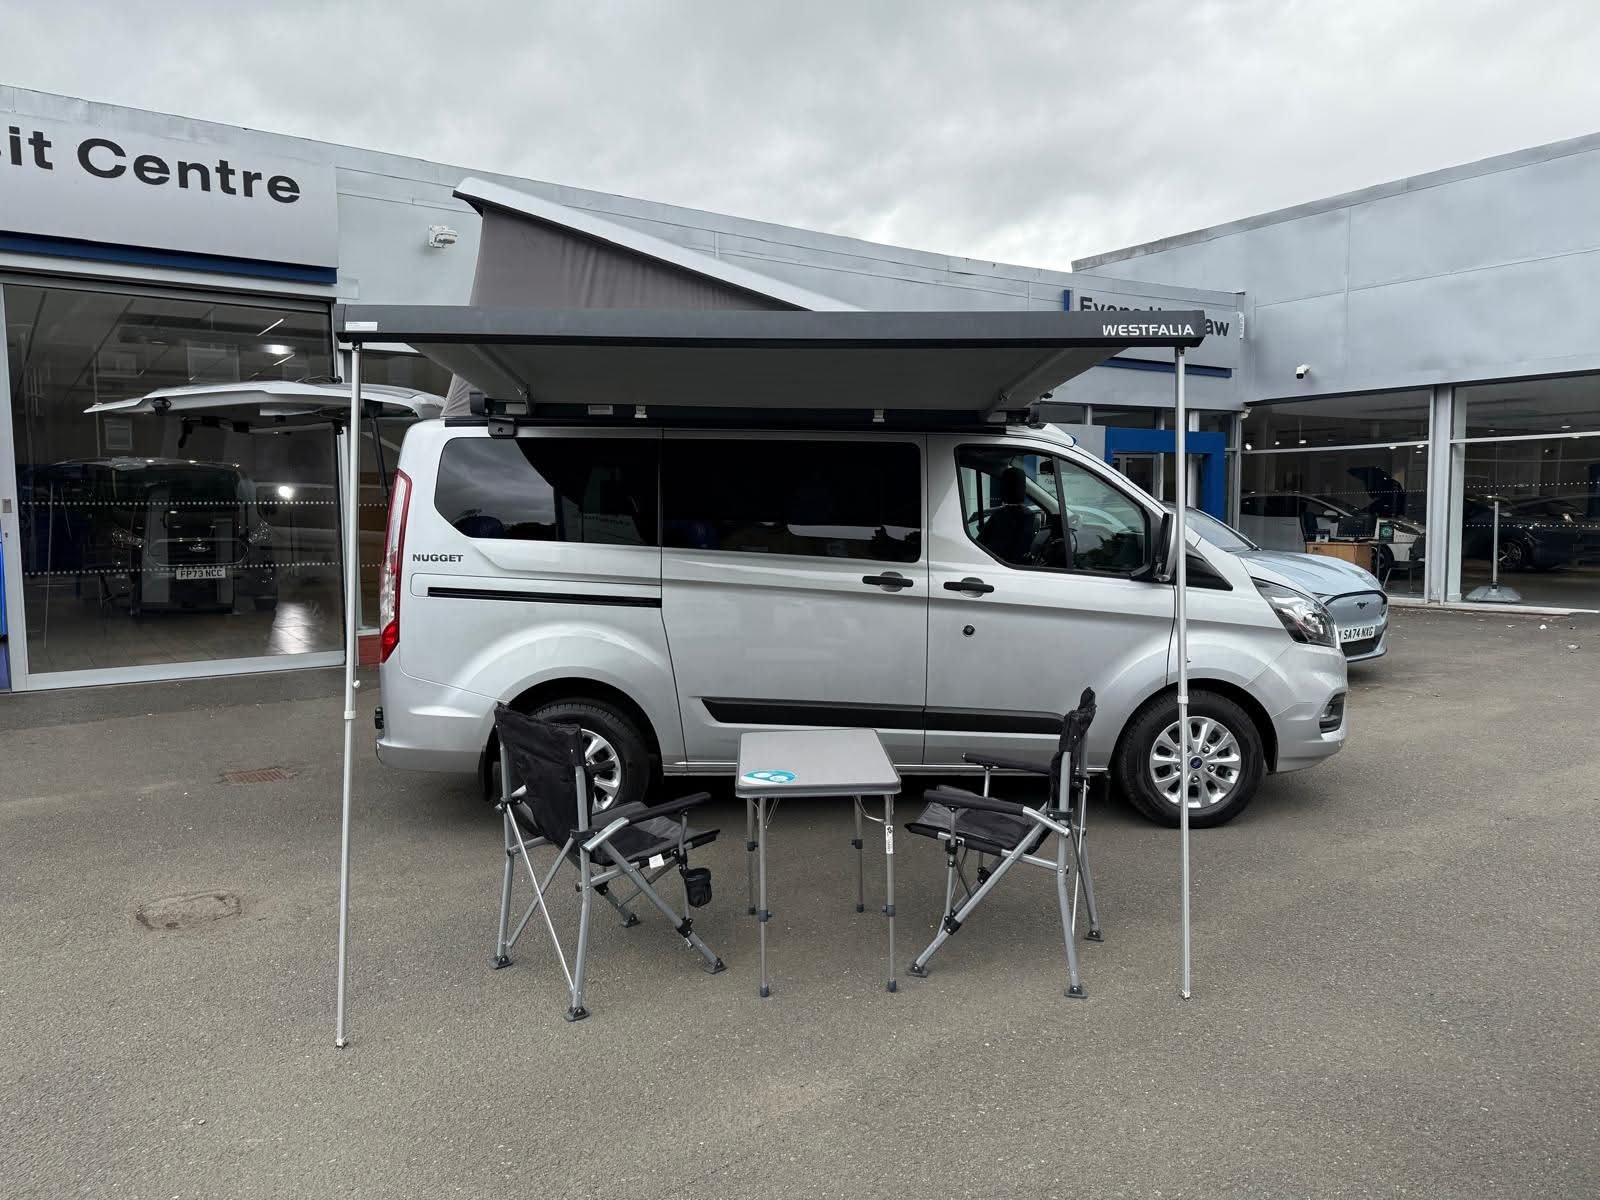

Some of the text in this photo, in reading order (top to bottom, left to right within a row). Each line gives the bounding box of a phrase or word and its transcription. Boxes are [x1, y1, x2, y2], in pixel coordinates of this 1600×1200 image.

[0, 126, 300, 203] it Centre
[1102, 324, 1195, 336] WESTFALIA
[412, 553, 464, 562] NUGGET
[1343, 628, 1360, 640] SA74
